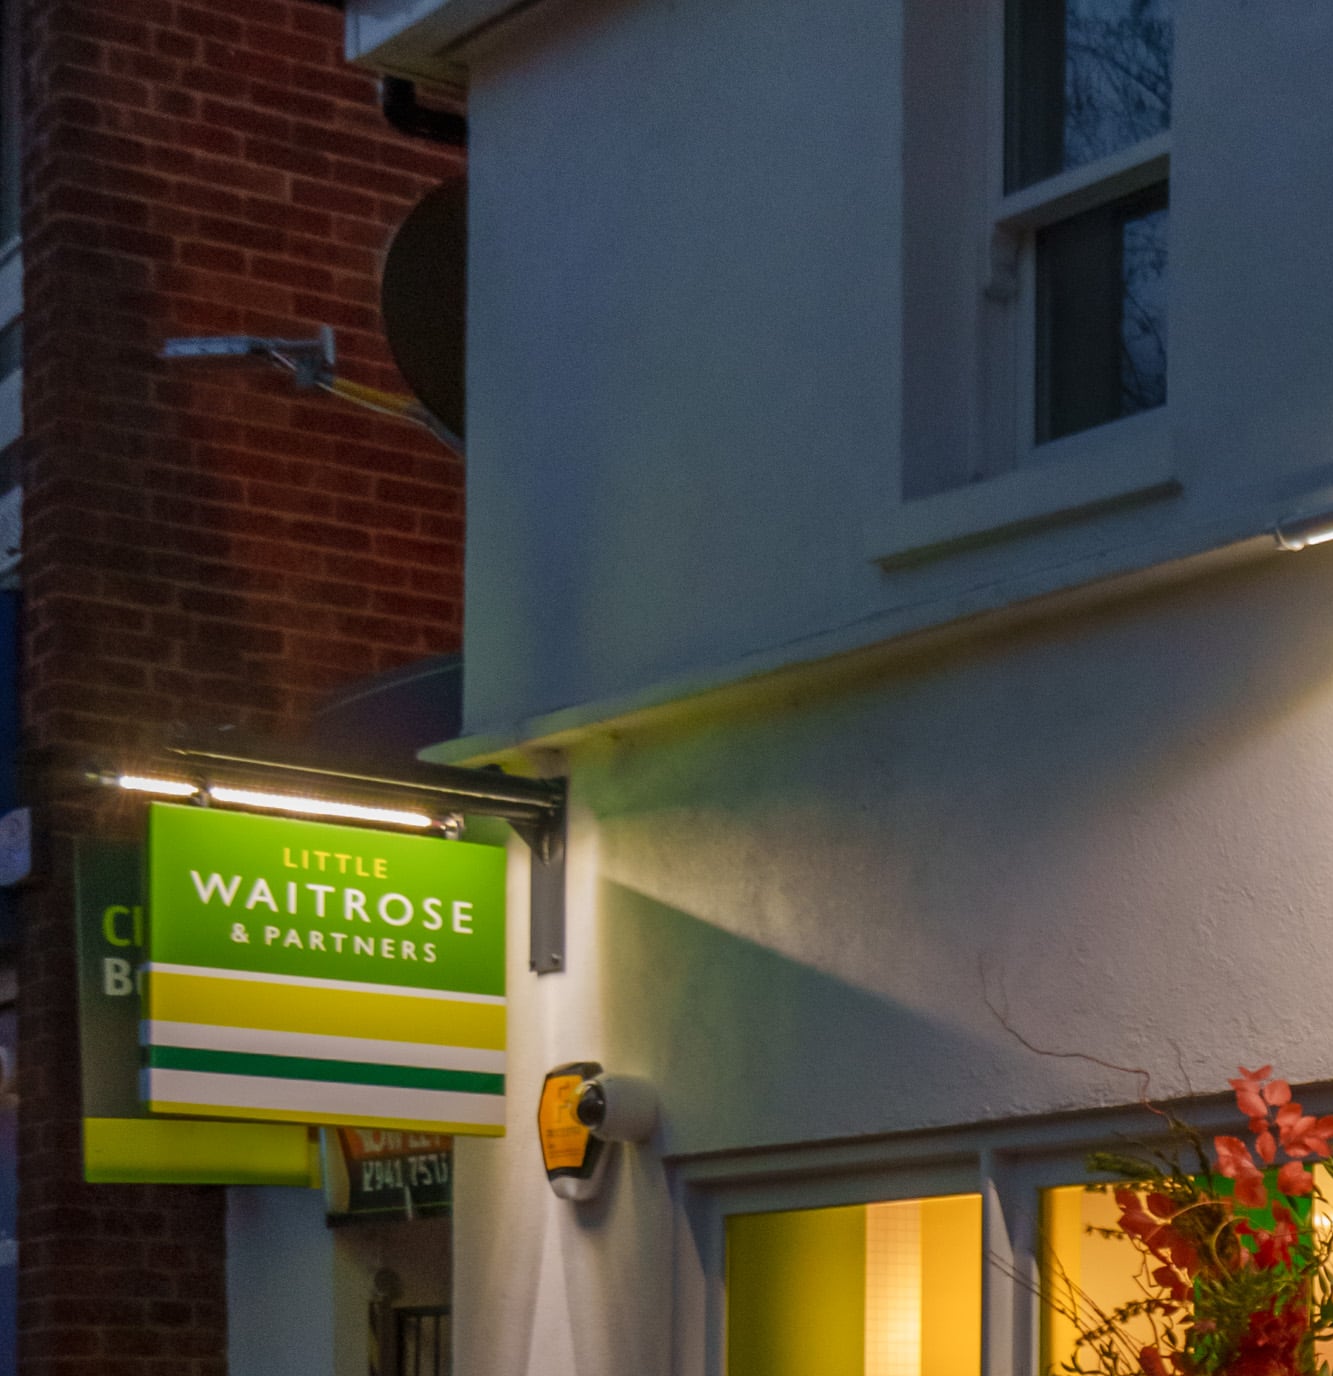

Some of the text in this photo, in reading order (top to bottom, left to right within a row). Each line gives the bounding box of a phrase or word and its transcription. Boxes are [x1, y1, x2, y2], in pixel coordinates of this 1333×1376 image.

[283, 847, 388, 879] LITTLE
[190, 869, 473, 934] WAITROSE
[231, 922, 437, 963] & PARTNERS
